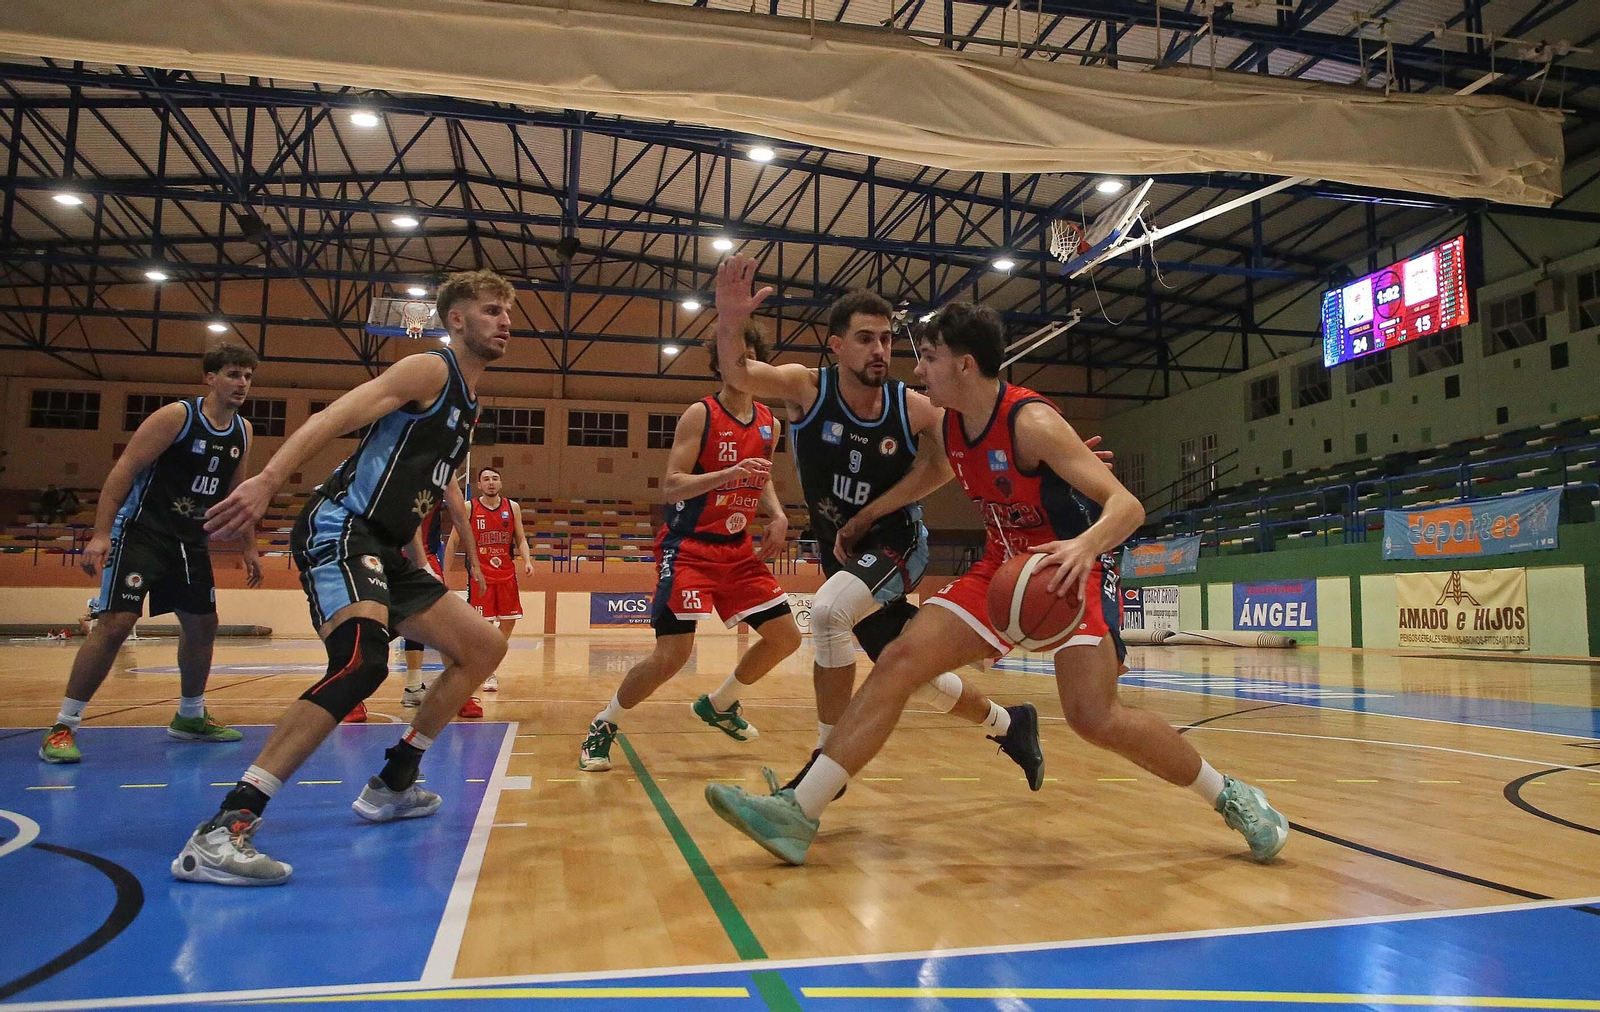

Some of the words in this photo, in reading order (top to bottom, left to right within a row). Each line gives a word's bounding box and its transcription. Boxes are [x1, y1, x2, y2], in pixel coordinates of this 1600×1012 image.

[1376, 285, 1400, 305] 1:02
[1415, 315, 1431, 333] 15
[1352, 336, 1368, 354] 24
[850, 433, 869, 444] vive
[718, 442, 737, 462] 25
[849, 449, 862, 473] 9
[207, 456, 220, 472] 0
[191, 475, 220, 495] ULB
[832, 474, 871, 506] ULB
[728, 493, 758, 507] Jaén
[477, 519, 486, 530] 16
[1407, 512, 1521, 552] deportes
[857, 553, 877, 567] 9
[368, 577, 387, 590] vive
[122, 593, 140, 602] vive
[608, 599, 647, 612] MGS
[682, 590, 702, 609] 25
[1239, 598, 1312, 627] ÁNGEL
[1399, 608, 1448, 630] AMADO
[1456, 612, 1466, 630] e
[1474, 607, 1525, 630] HIJOS
